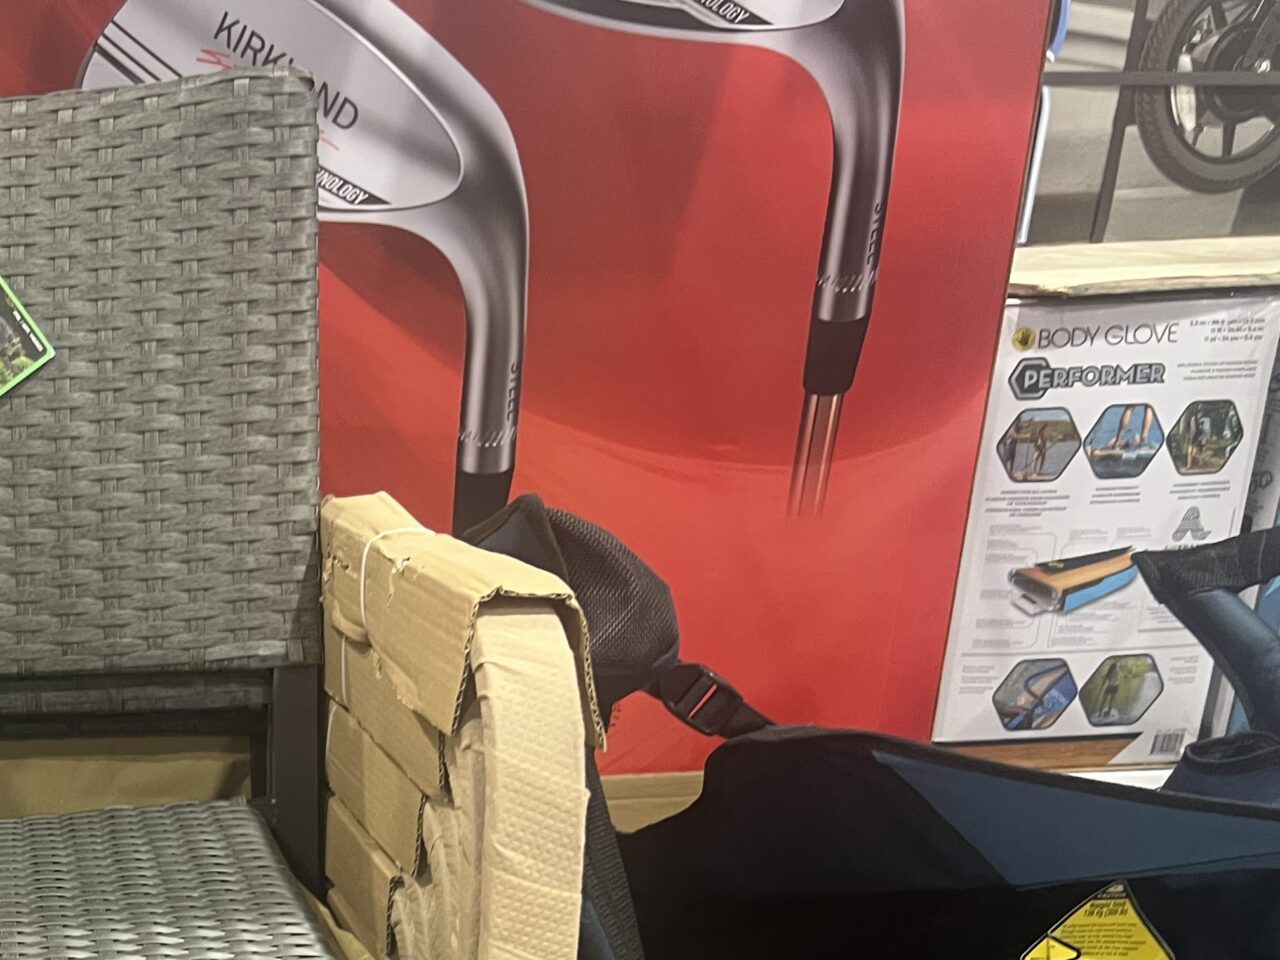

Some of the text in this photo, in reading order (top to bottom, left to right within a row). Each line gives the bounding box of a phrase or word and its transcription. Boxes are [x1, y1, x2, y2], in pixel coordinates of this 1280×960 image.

[214, 11, 359, 130] KIRKND
[1038, 322, 1180, 349] BODY GLOVE
[1023, 362, 1166, 391] PERFORMER
